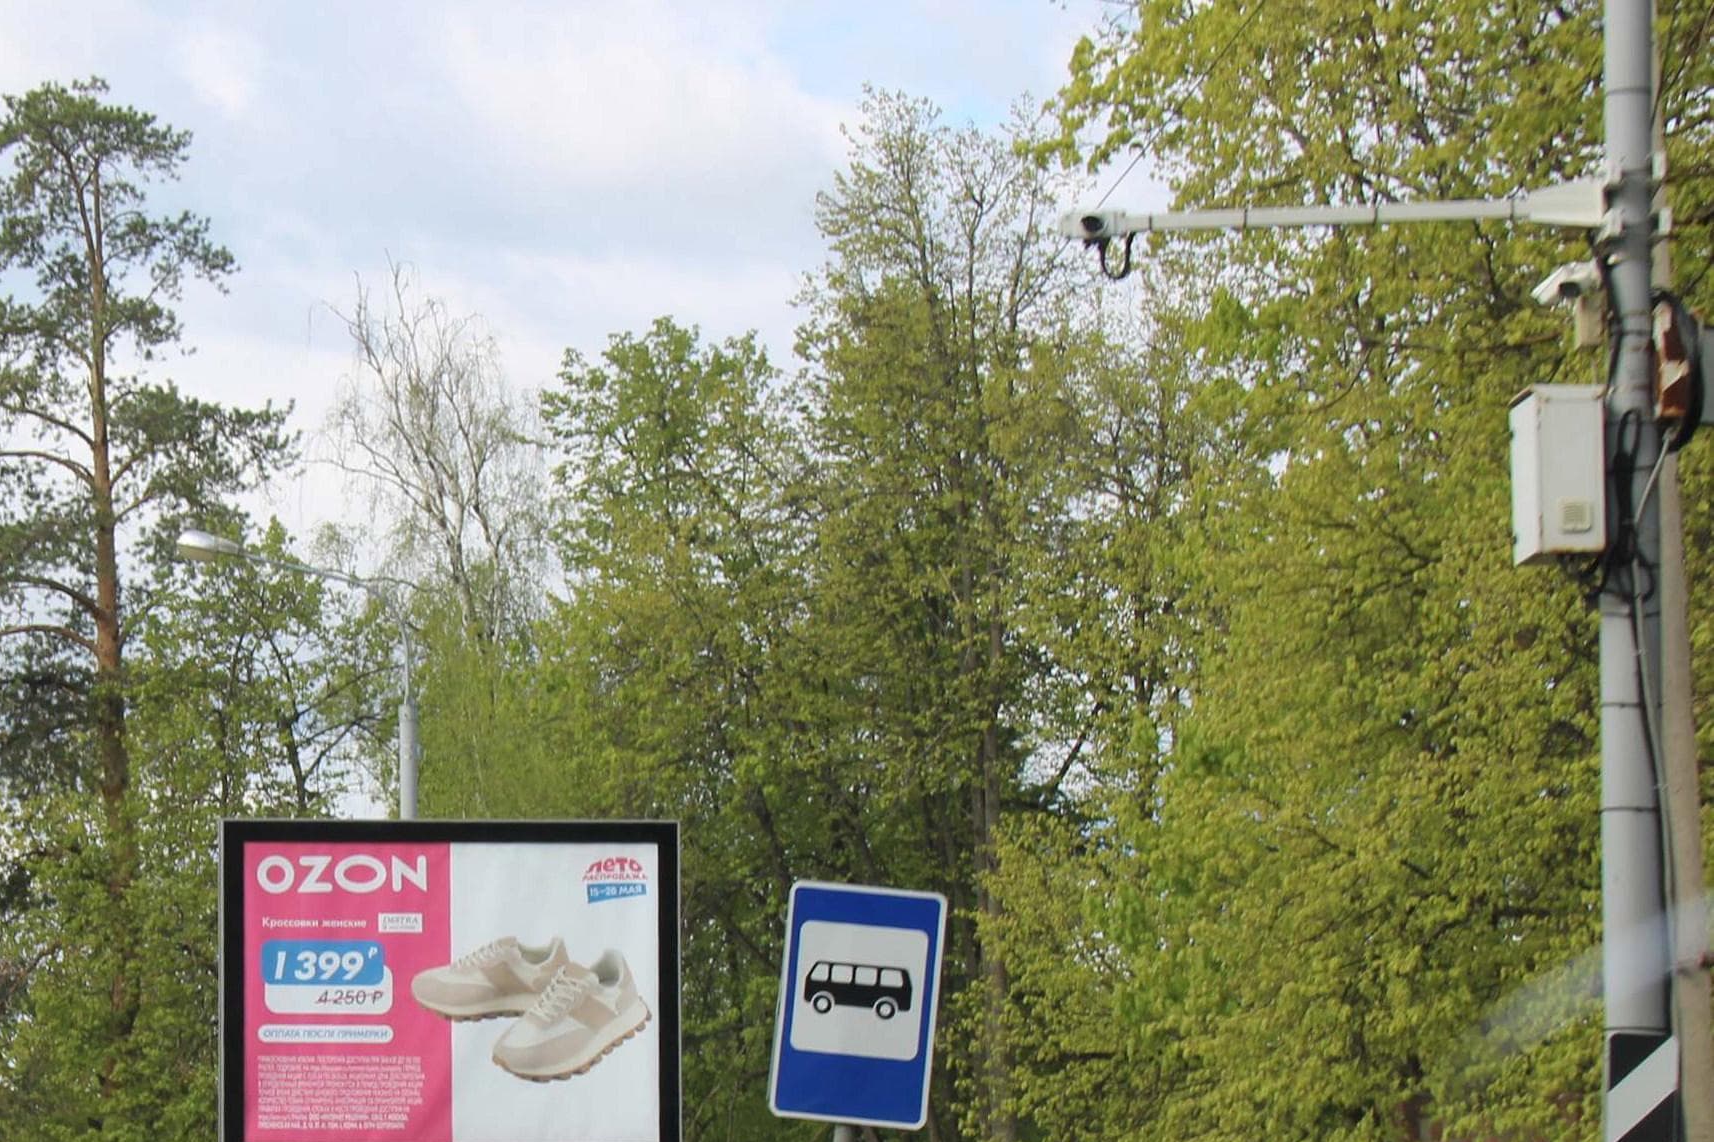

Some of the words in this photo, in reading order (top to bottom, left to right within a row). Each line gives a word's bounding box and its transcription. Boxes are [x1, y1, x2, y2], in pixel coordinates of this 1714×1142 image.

[256, 854, 428, 894] OZON
[619, 885, 642, 895] МАЯ
[262, 917, 319, 929] Кроссовки
[322, 919, 367, 929] женские
[263, 1029, 300, 1038] ОПЛАТА
[303, 1029, 335, 1038] ПОСЛЕ
